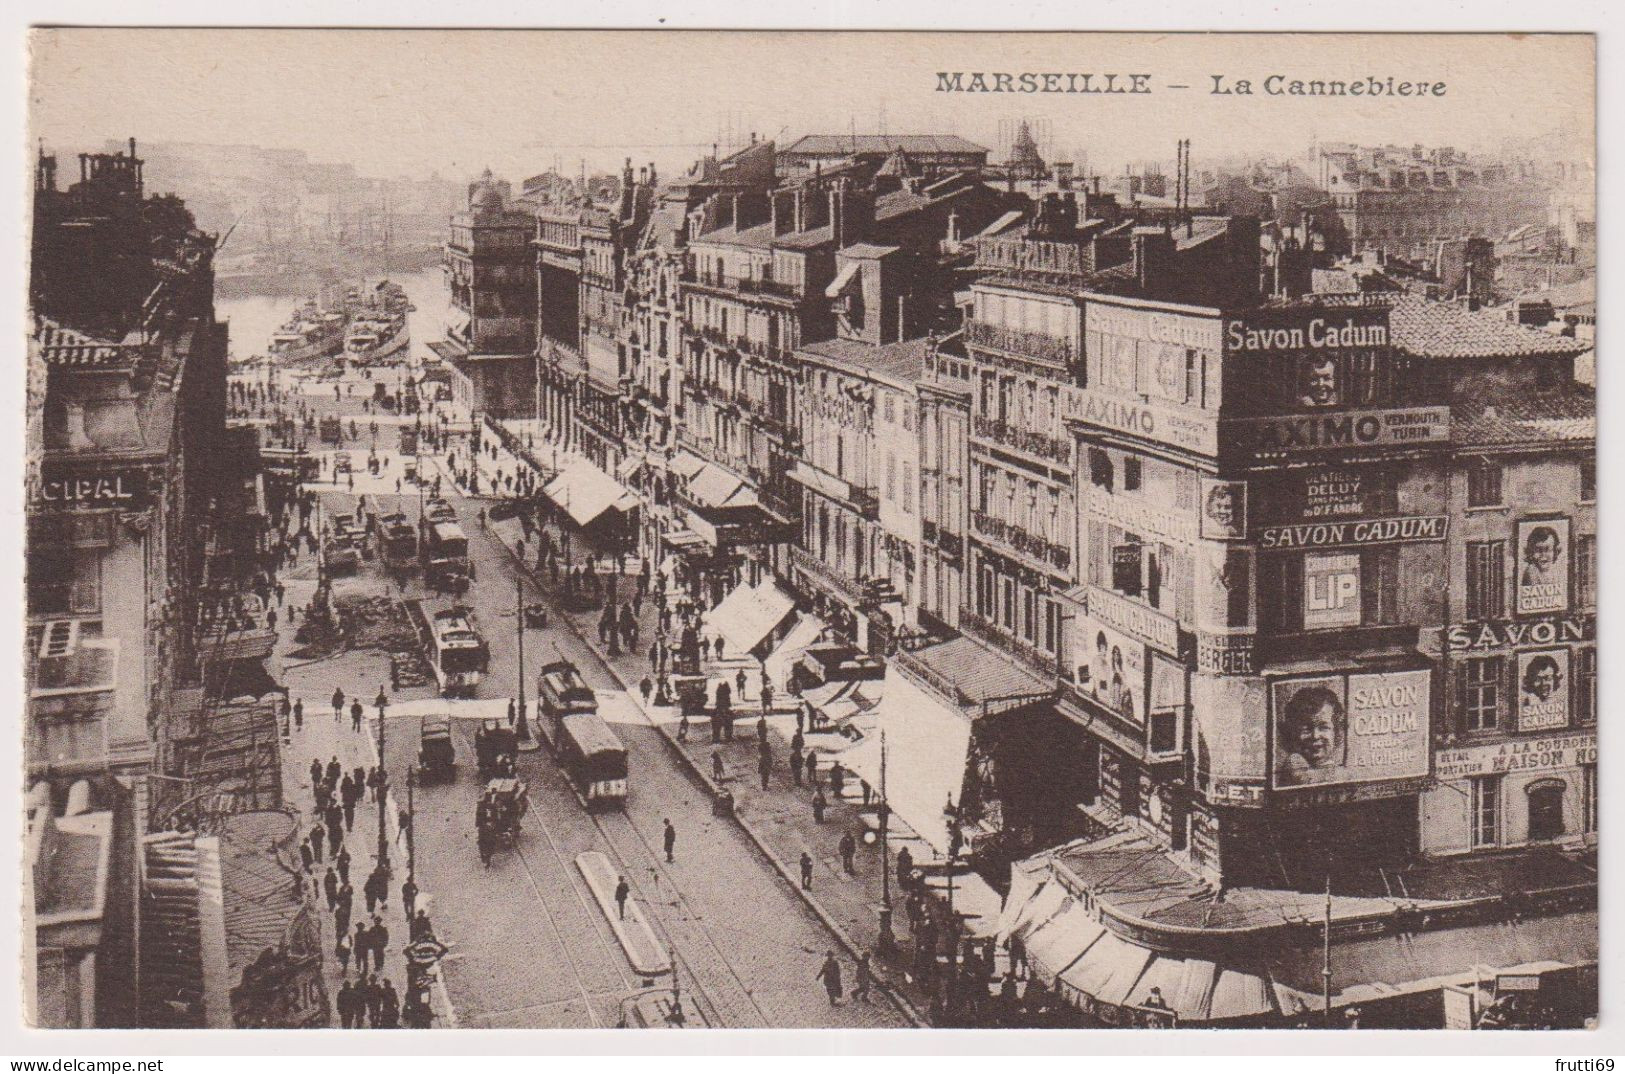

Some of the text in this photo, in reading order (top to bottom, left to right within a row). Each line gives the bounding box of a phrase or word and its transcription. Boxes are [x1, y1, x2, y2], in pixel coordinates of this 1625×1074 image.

[1228, 318, 1387, 350] Savon Cadum
[1067, 391, 1155, 434] MAXIMO
[1384, 411, 1441, 426] VERMOUTH
[1391, 426, 1431, 439] TURIN
[1308, 482, 1361, 496] DELUY
[1263, 525, 1345, 547] SAVON
[1308, 573, 1357, 610] LIP
[1521, 584, 1562, 598] SAVON
[1521, 598, 1562, 610] CADUM
[1449, 620, 1584, 650] SAVON
[1354, 686, 1418, 711] SAVON
[1522, 702, 1566, 717] SAVON
[1354, 711, 1418, 736] CADUM
[1513, 742, 1531, 754] LA
[1492, 750, 1564, 772] MAISON
